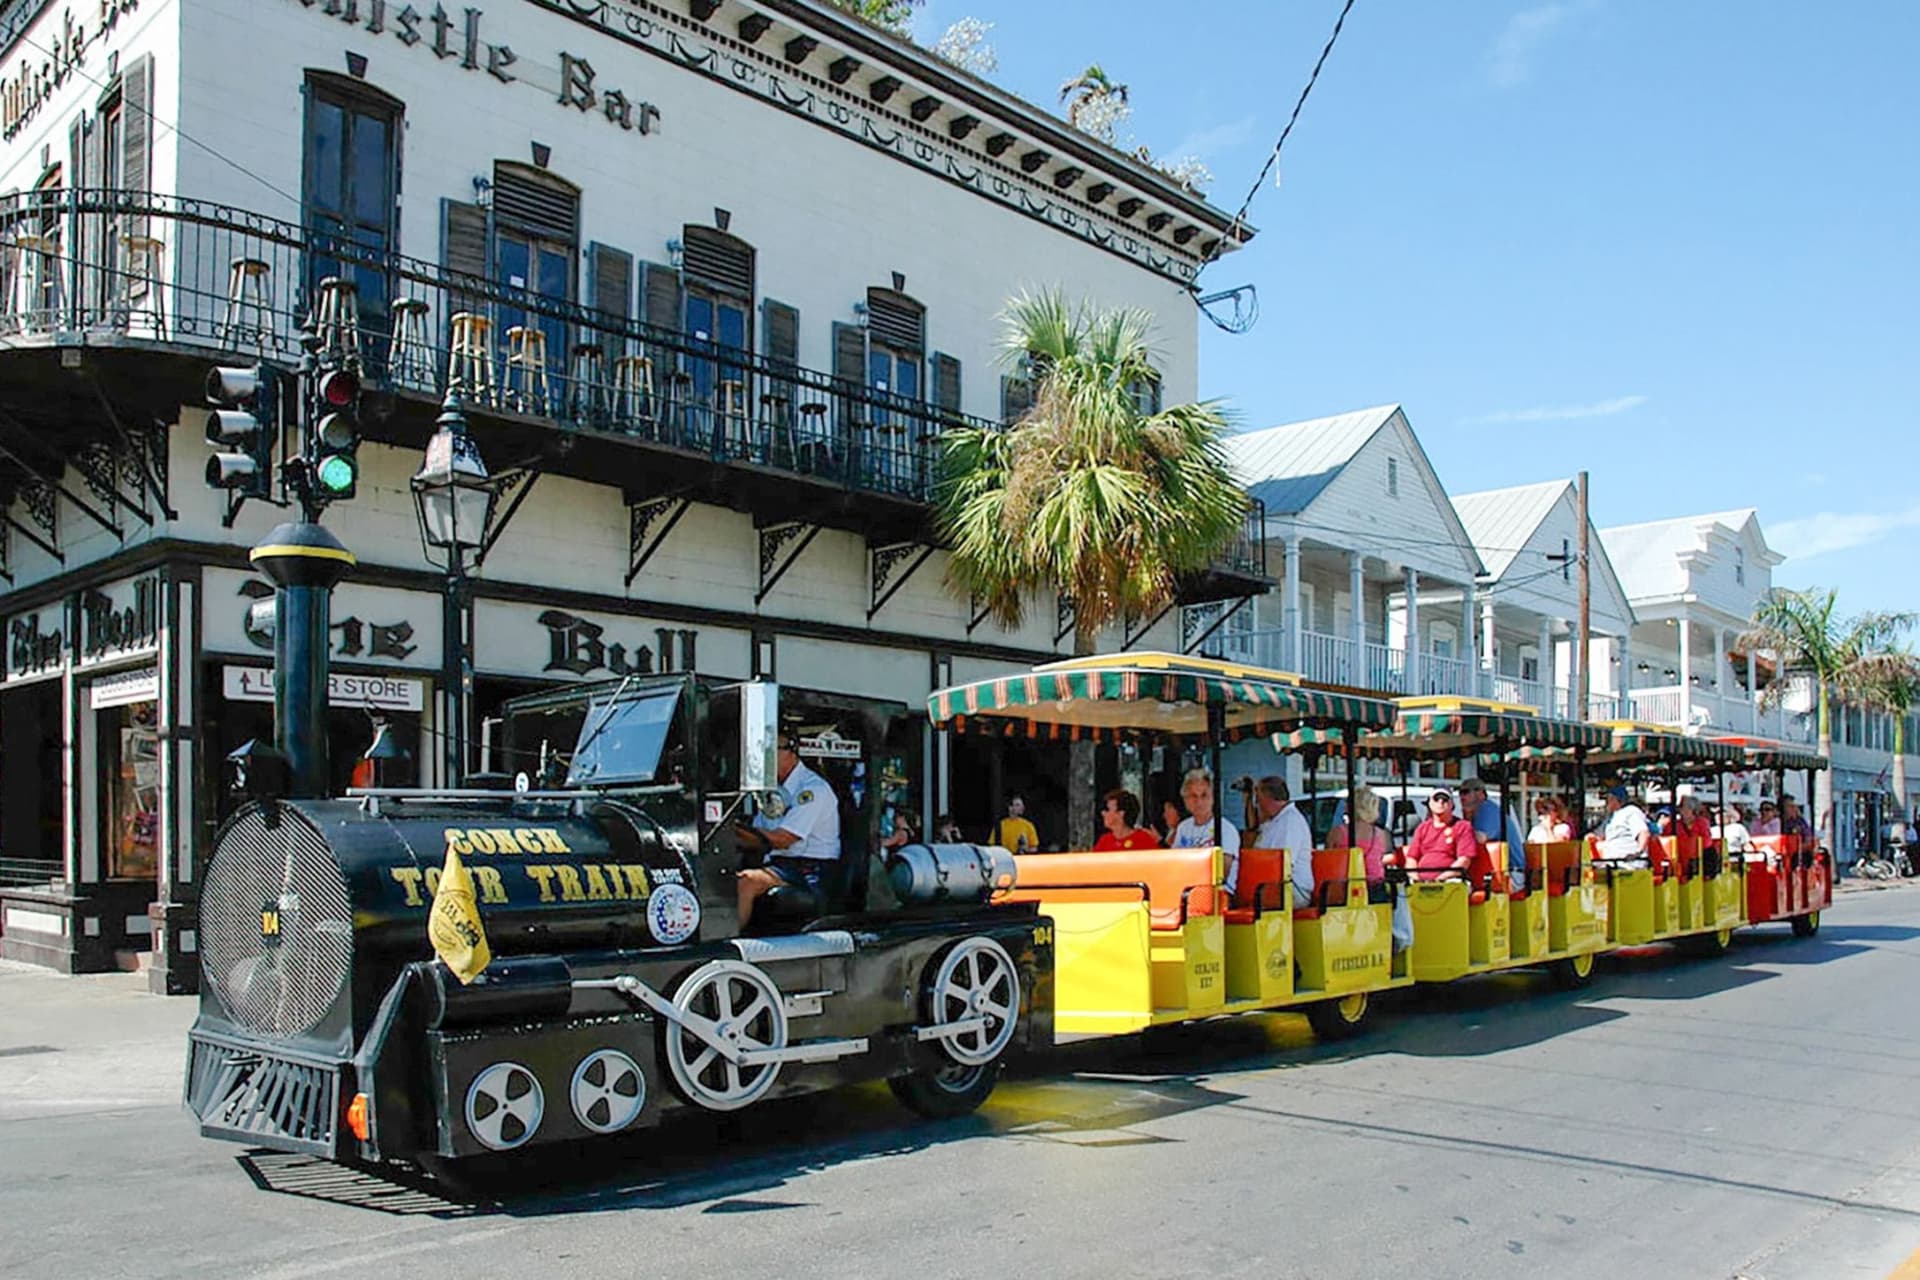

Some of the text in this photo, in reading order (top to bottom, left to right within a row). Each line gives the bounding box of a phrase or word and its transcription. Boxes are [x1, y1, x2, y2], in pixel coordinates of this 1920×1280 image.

[299, 0, 661, 136] istle Bar
[83, 581, 157, 662] Bull
[537, 610, 698, 676] Bull
[343, 678, 409, 698] STORE
[444, 828, 571, 855] CONCH
[390, 863, 650, 906] TOR TRAIN
